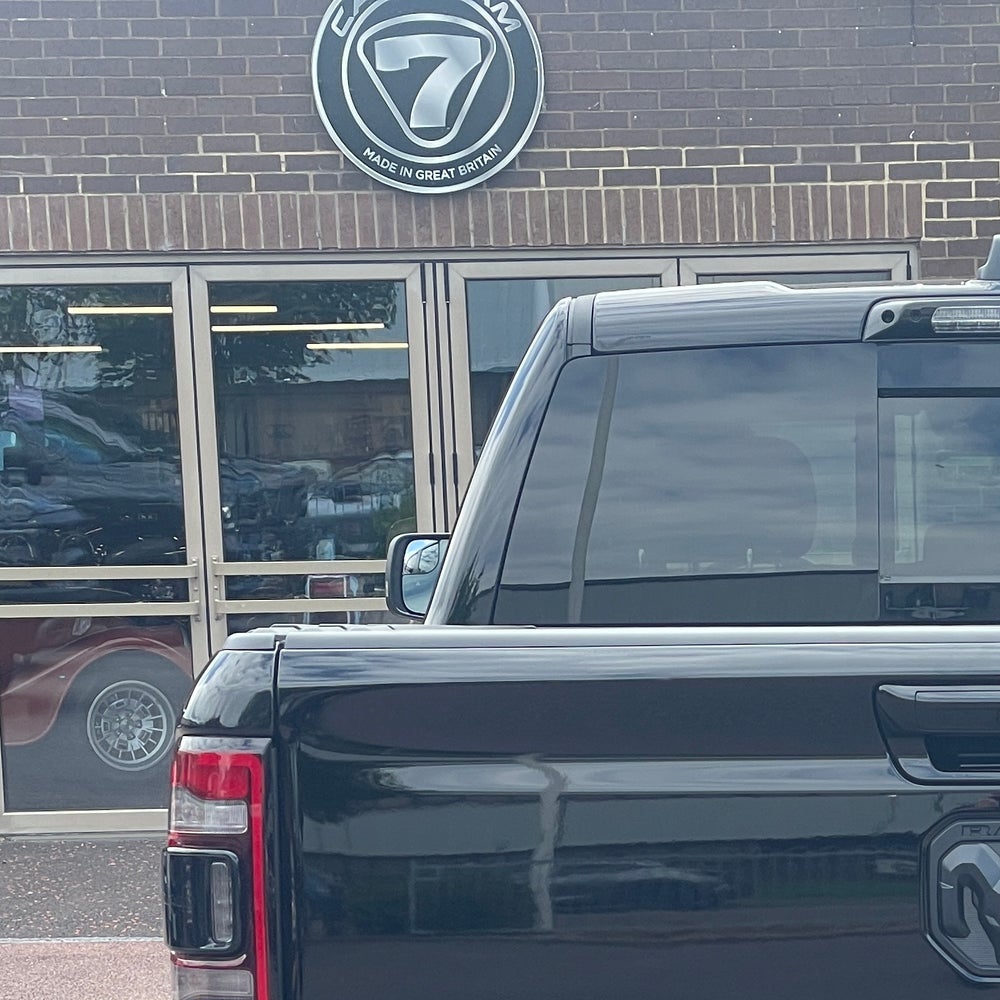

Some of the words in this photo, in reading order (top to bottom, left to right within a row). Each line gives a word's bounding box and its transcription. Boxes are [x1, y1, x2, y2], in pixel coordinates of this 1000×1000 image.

[374, 33, 482, 128] 7
[362, 147, 399, 174] MADE
[399, 165, 413, 178] IN
[415, 167, 456, 181] GREAT
[458, 144, 503, 176] BRITAIN
